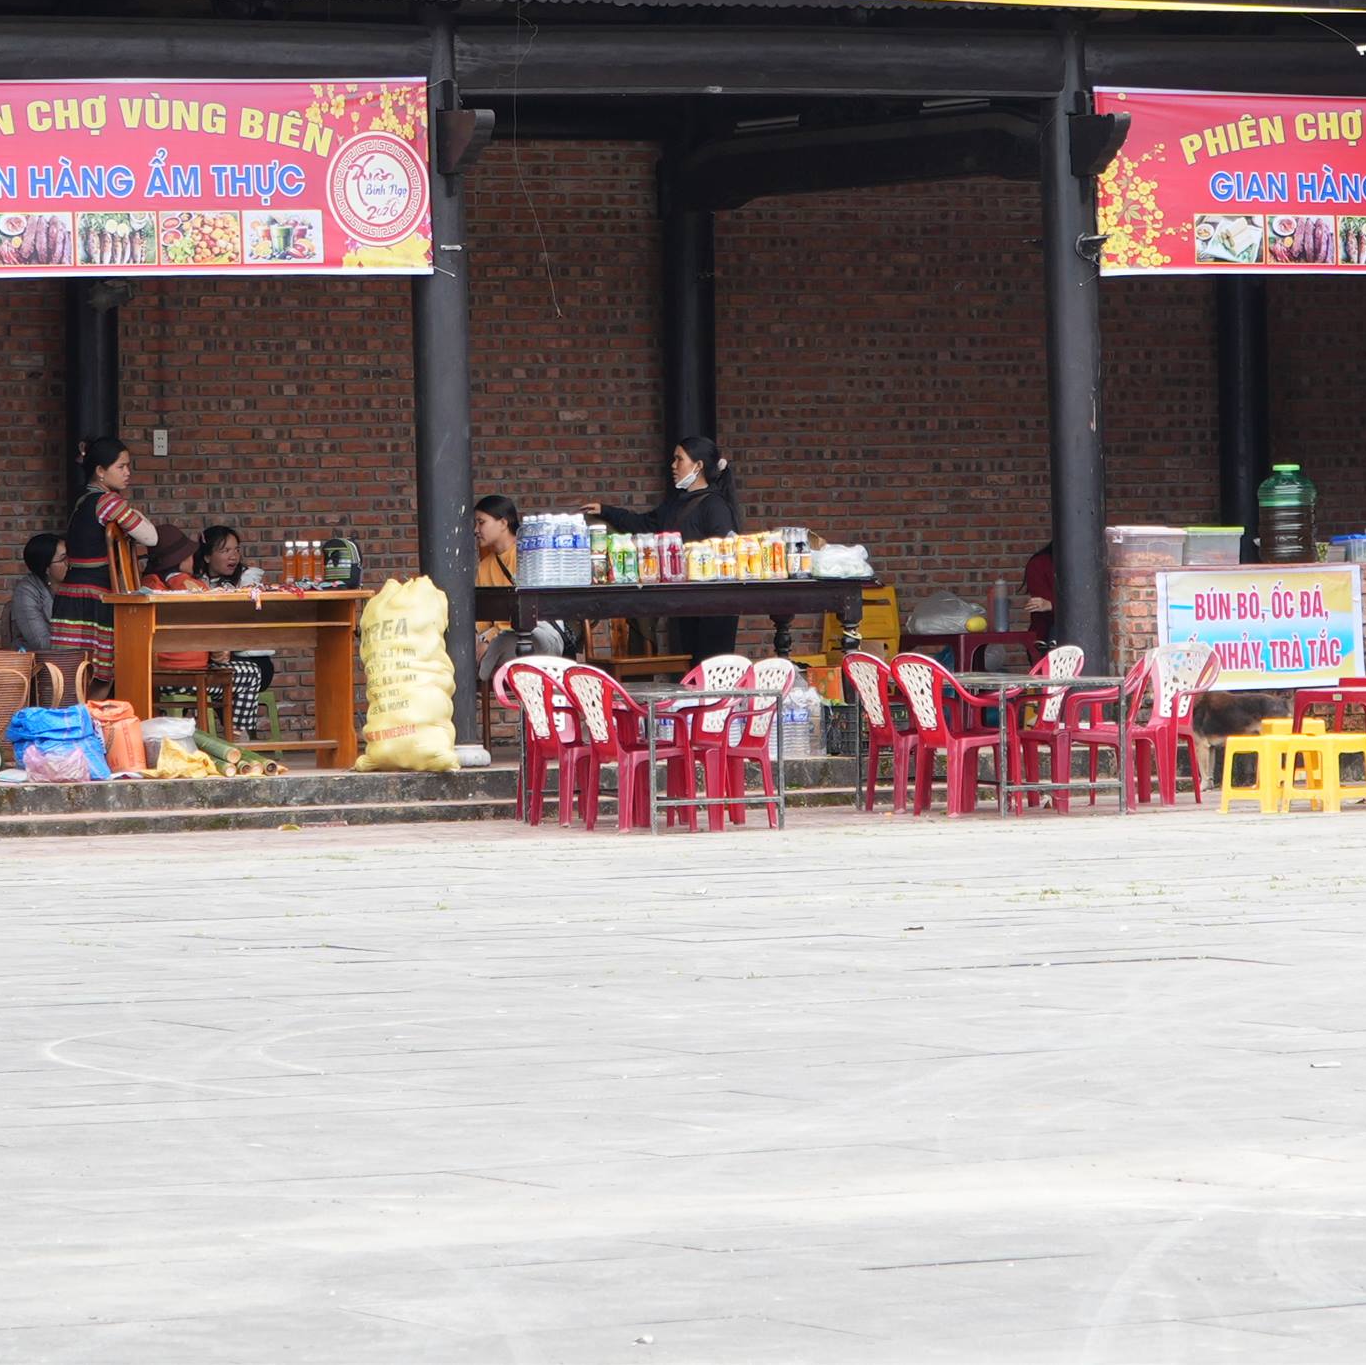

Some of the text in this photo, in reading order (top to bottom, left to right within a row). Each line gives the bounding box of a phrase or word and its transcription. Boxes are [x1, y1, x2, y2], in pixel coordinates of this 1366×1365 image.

[26, 95, 107, 136] CHỢ
[118, 92, 227, 135] VÙNG
[239, 107, 334, 158] BIÊN
[1179, 114, 1285, 165] PHIÊN
[1294, 109, 1363, 146] CHỢ
[28, 156, 135, 199] HÀNG
[144, 147, 201, 198] ẨM
[210, 159, 306, 206] THỰC
[1209, 171, 1288, 202] GIAN
[367, 200, 398, 221] 2026
[1195, 581, 1329, 623] BÚN BÒ, ỐC ĐÁ,
[1269, 635, 1304, 669] TRÀ
[1307, 629, 1342, 667] TẮC
